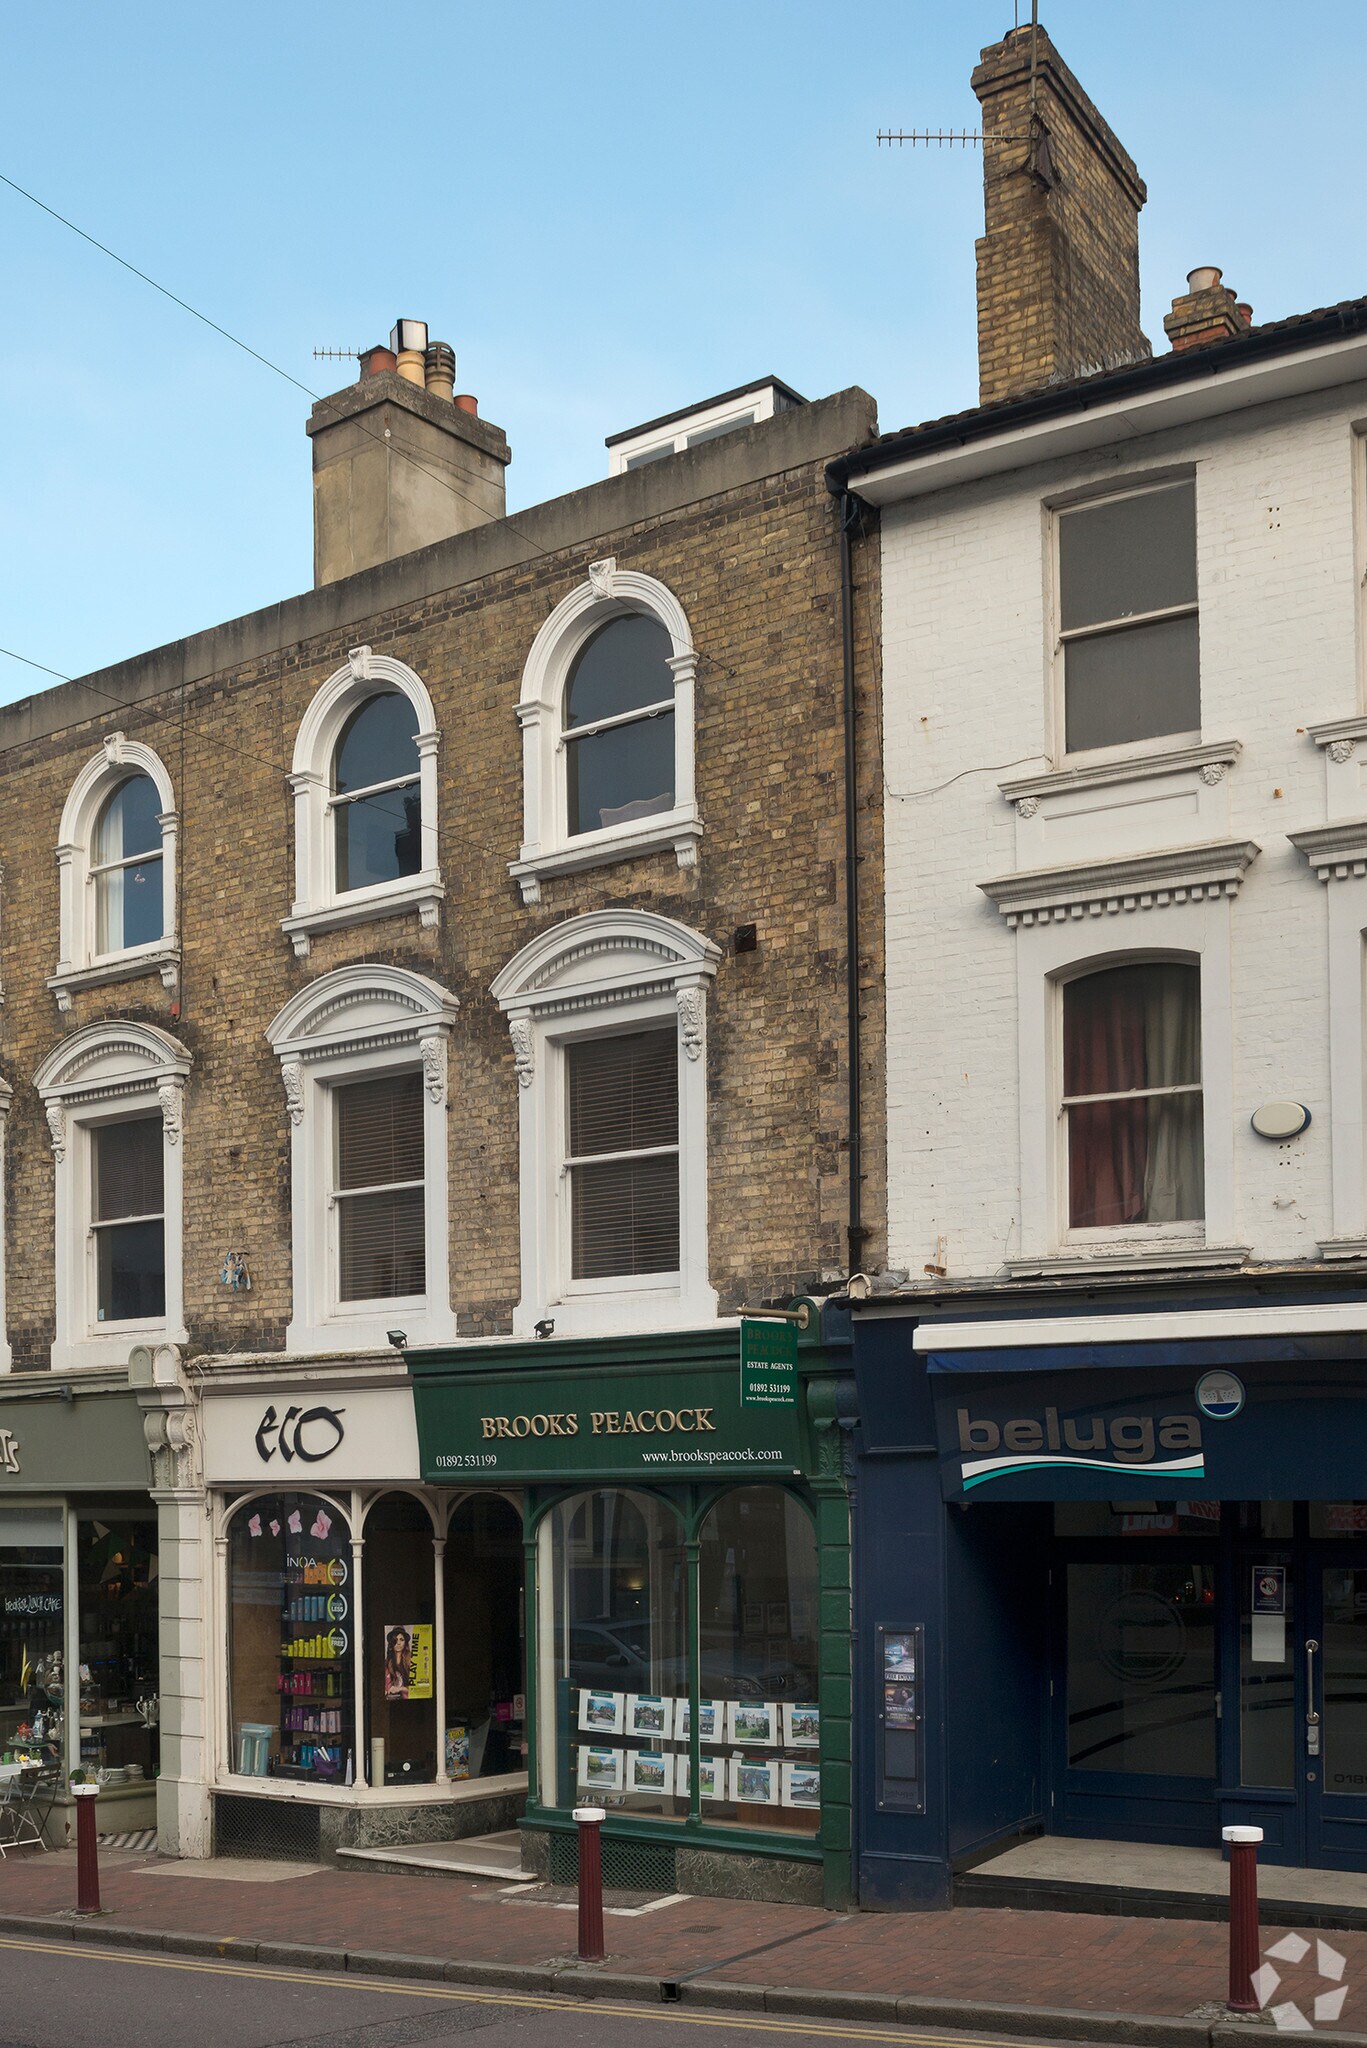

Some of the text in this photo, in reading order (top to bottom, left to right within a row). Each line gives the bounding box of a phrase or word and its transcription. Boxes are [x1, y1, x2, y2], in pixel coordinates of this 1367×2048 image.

[746, 1361, 794, 1371] ESTATE AGENTS
[749, 1383, 791, 1393] 01892 531199
[745, 1395, 794, 1403] www.brookspeacock.com
[480, 1408, 717, 1438] BROOKS PEACOCK
[957, 1407, 1202, 1463] beluga
[436, 1454, 497, 1467] 01892 531199
[641, 1448, 783, 1465] www.brookspeacock.com
[408, 1633, 420, 1686] PLAY TIME
[1334, 1773, 1367, 1785] 018
